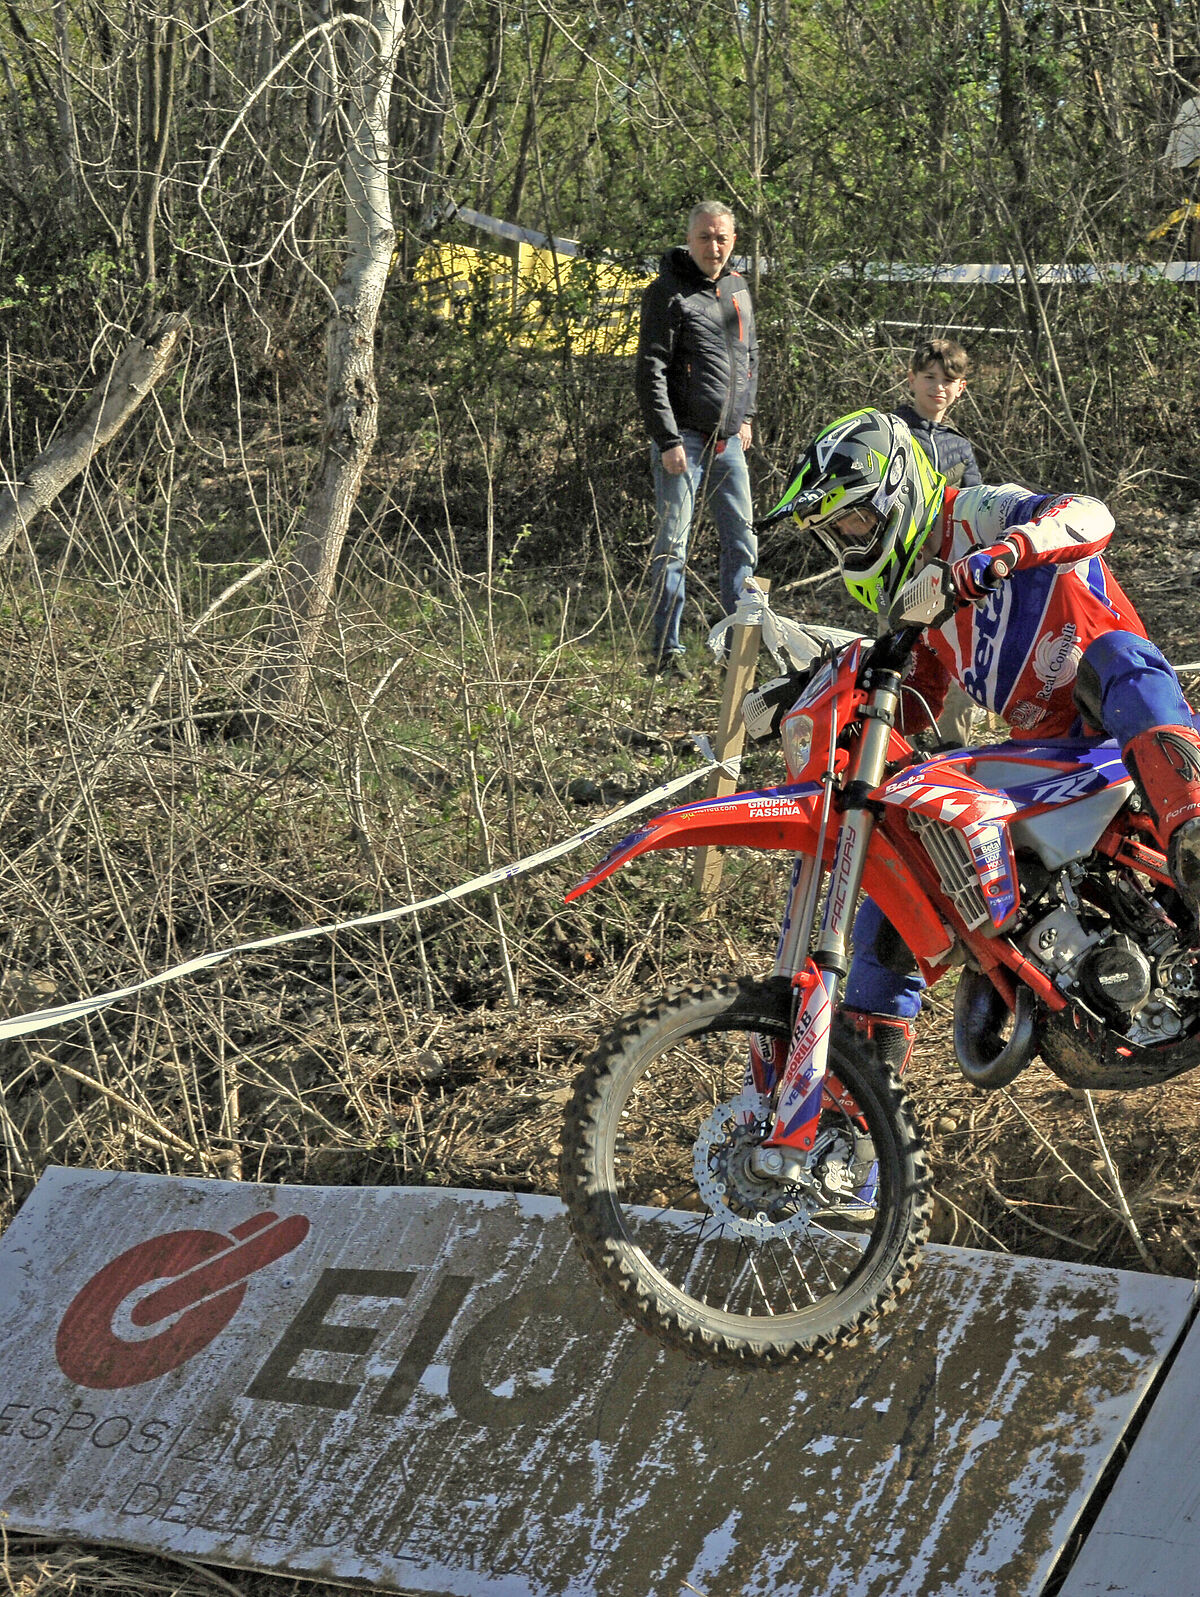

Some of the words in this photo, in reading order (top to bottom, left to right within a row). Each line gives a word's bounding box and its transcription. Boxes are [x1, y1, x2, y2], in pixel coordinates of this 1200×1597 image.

[964, 579, 1005, 707] Beta
[1037, 674, 1056, 701] Real
[1050, 623, 1076, 672] Consult
[748, 798, 796, 809] GRUPPO
[886, 774, 925, 794] Beta
[749, 806, 801, 818] FASSINA
[981, 841, 999, 854] Beta
[831, 825, 856, 935] FACTORY
[0, 1403, 356, 1485] ESPOSIZIONE
